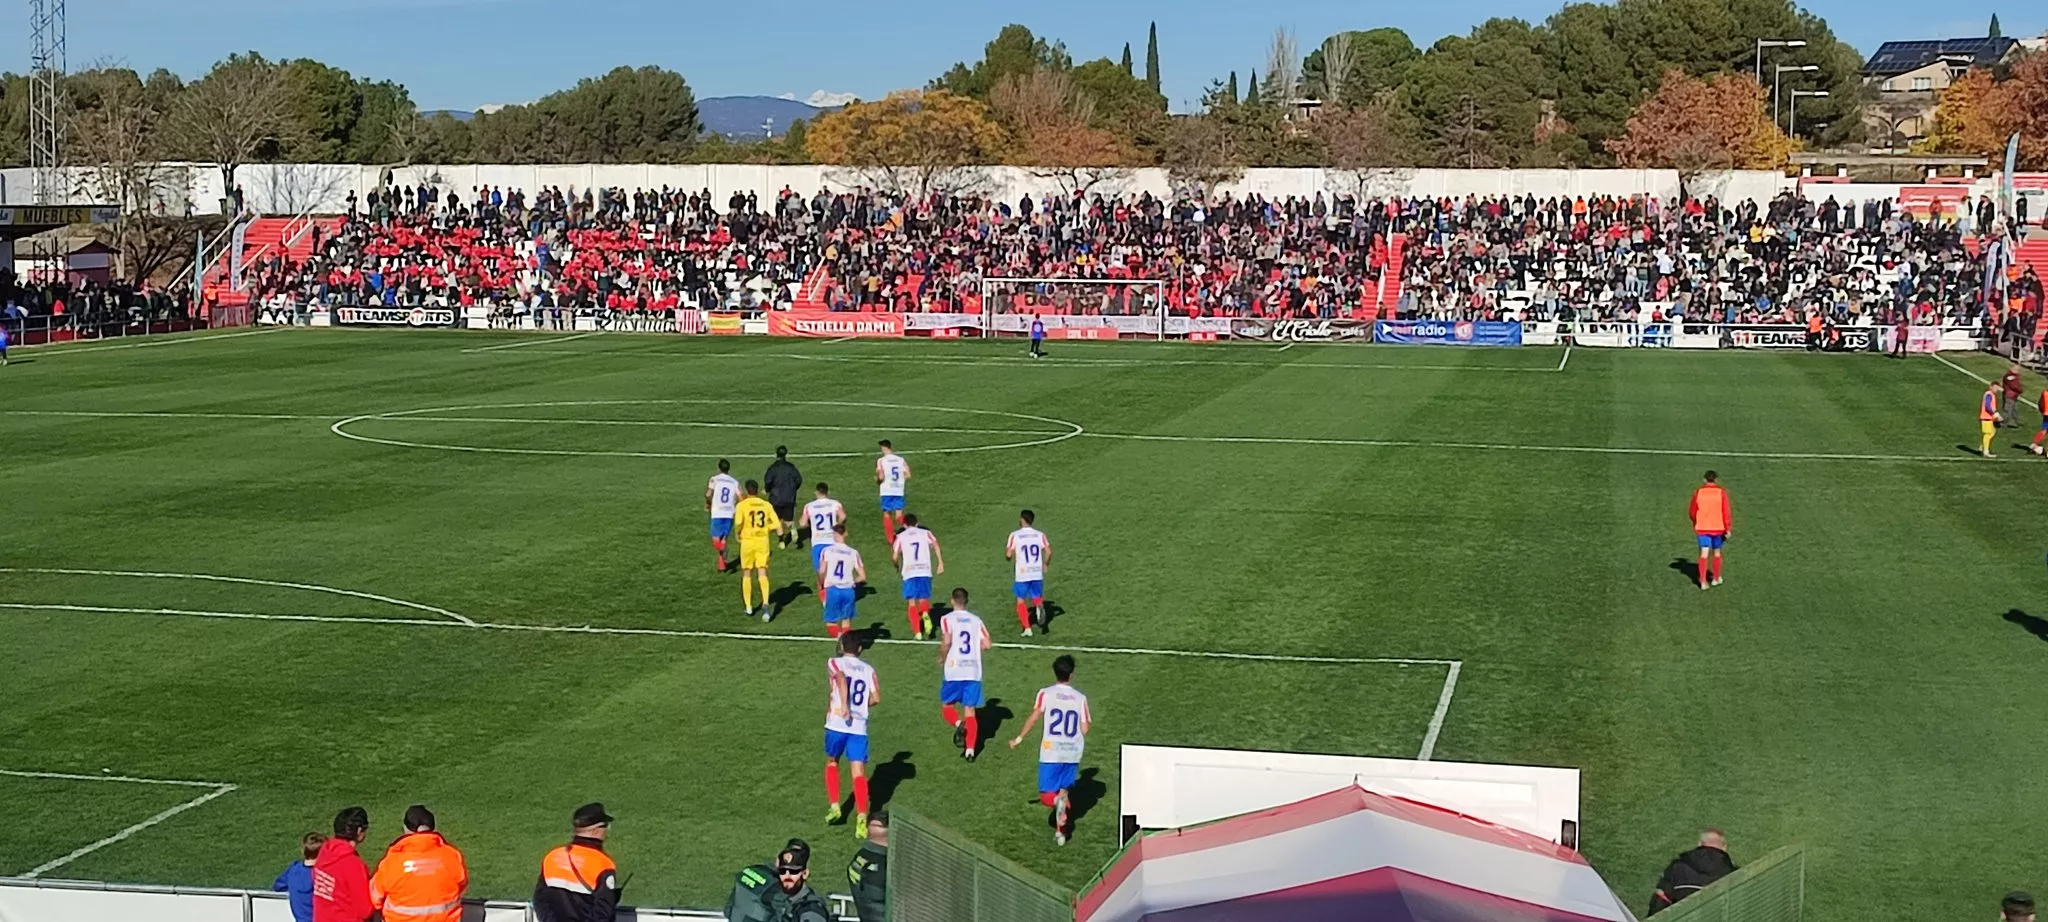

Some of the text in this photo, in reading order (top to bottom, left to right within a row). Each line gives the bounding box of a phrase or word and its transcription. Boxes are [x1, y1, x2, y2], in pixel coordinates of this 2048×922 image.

[24, 209, 82, 223] MUEBLES
[796, 320, 895, 333] ESTRELLA DAMM
[1290, 320, 1333, 341] Criollo
[891, 466, 899, 482] 5
[720, 487, 730, 503] 8
[748, 510, 766, 528] 13
[815, 511, 834, 531] 21
[911, 542, 920, 561] 7
[1021, 544, 1040, 564] 19
[834, 560, 844, 580] 4
[959, 631, 971, 654] 3
[846, 676, 866, 706] 18
[1049, 708, 1079, 738] 20
